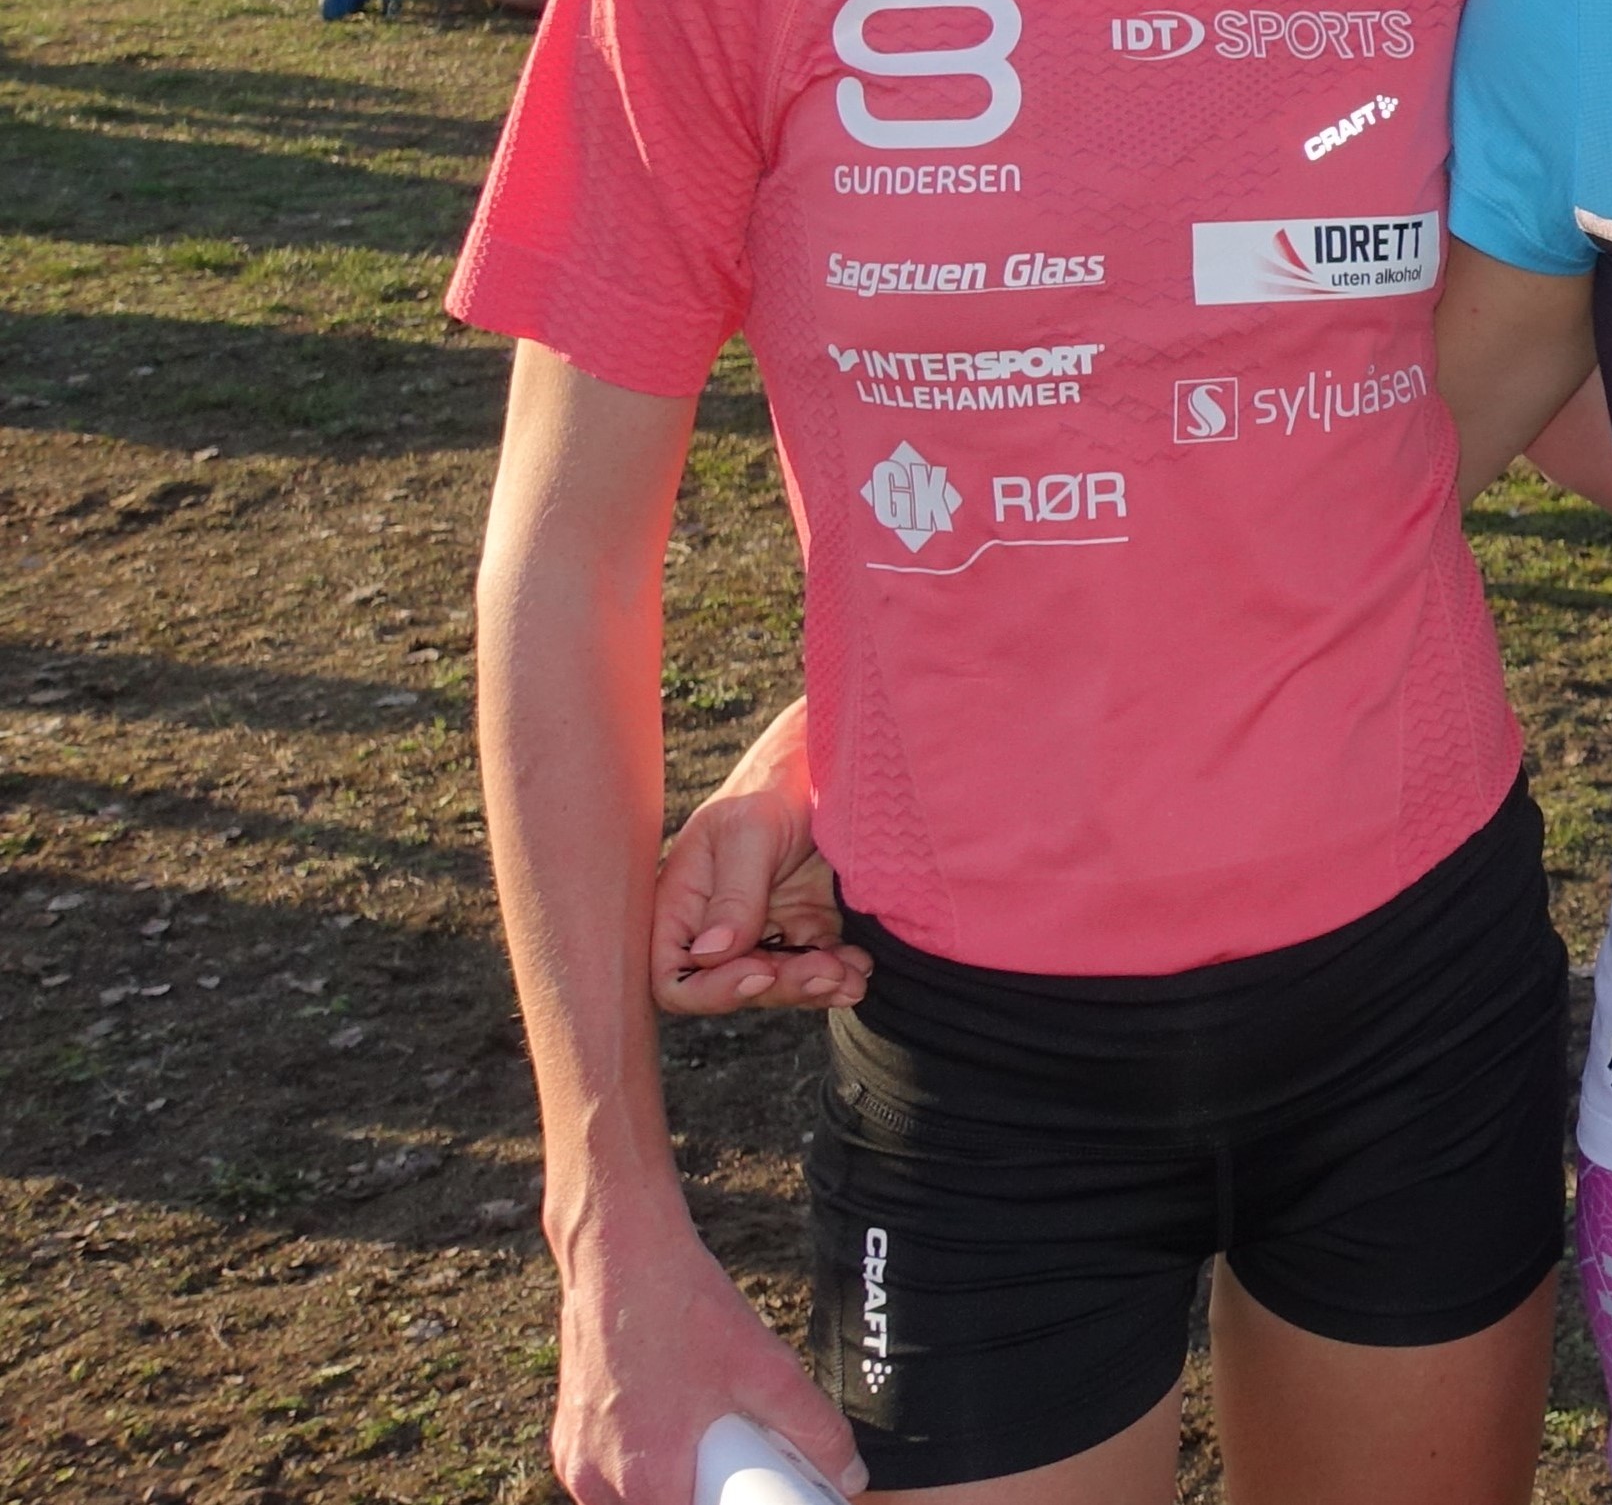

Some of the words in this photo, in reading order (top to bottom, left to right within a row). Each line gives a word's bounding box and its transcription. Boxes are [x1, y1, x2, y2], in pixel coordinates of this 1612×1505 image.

[1111, 19, 1179, 51] IDT
[1214, 9, 1415, 60] SPORTS
[1304, 101, 1376, 161] CRAFT
[834, 164, 1021, 195] GUNDERSEN
[1314, 221, 1424, 265] IDRETT
[826, 252, 987, 297] Sagstuen
[1003, 252, 1106, 288] Glass
[1331, 270, 1371, 287] uten
[1375, 264, 1422, 285] alkohol
[861, 343, 1099, 382] INTERSPORT
[856, 381, 1081, 411] LILLEHAMMER
[1253, 364, 1427, 436] syljuåsen
[872, 460, 954, 533] GK
[992, 471, 1128, 523] RØR
[862, 1227, 888, 1358] CRAFT
